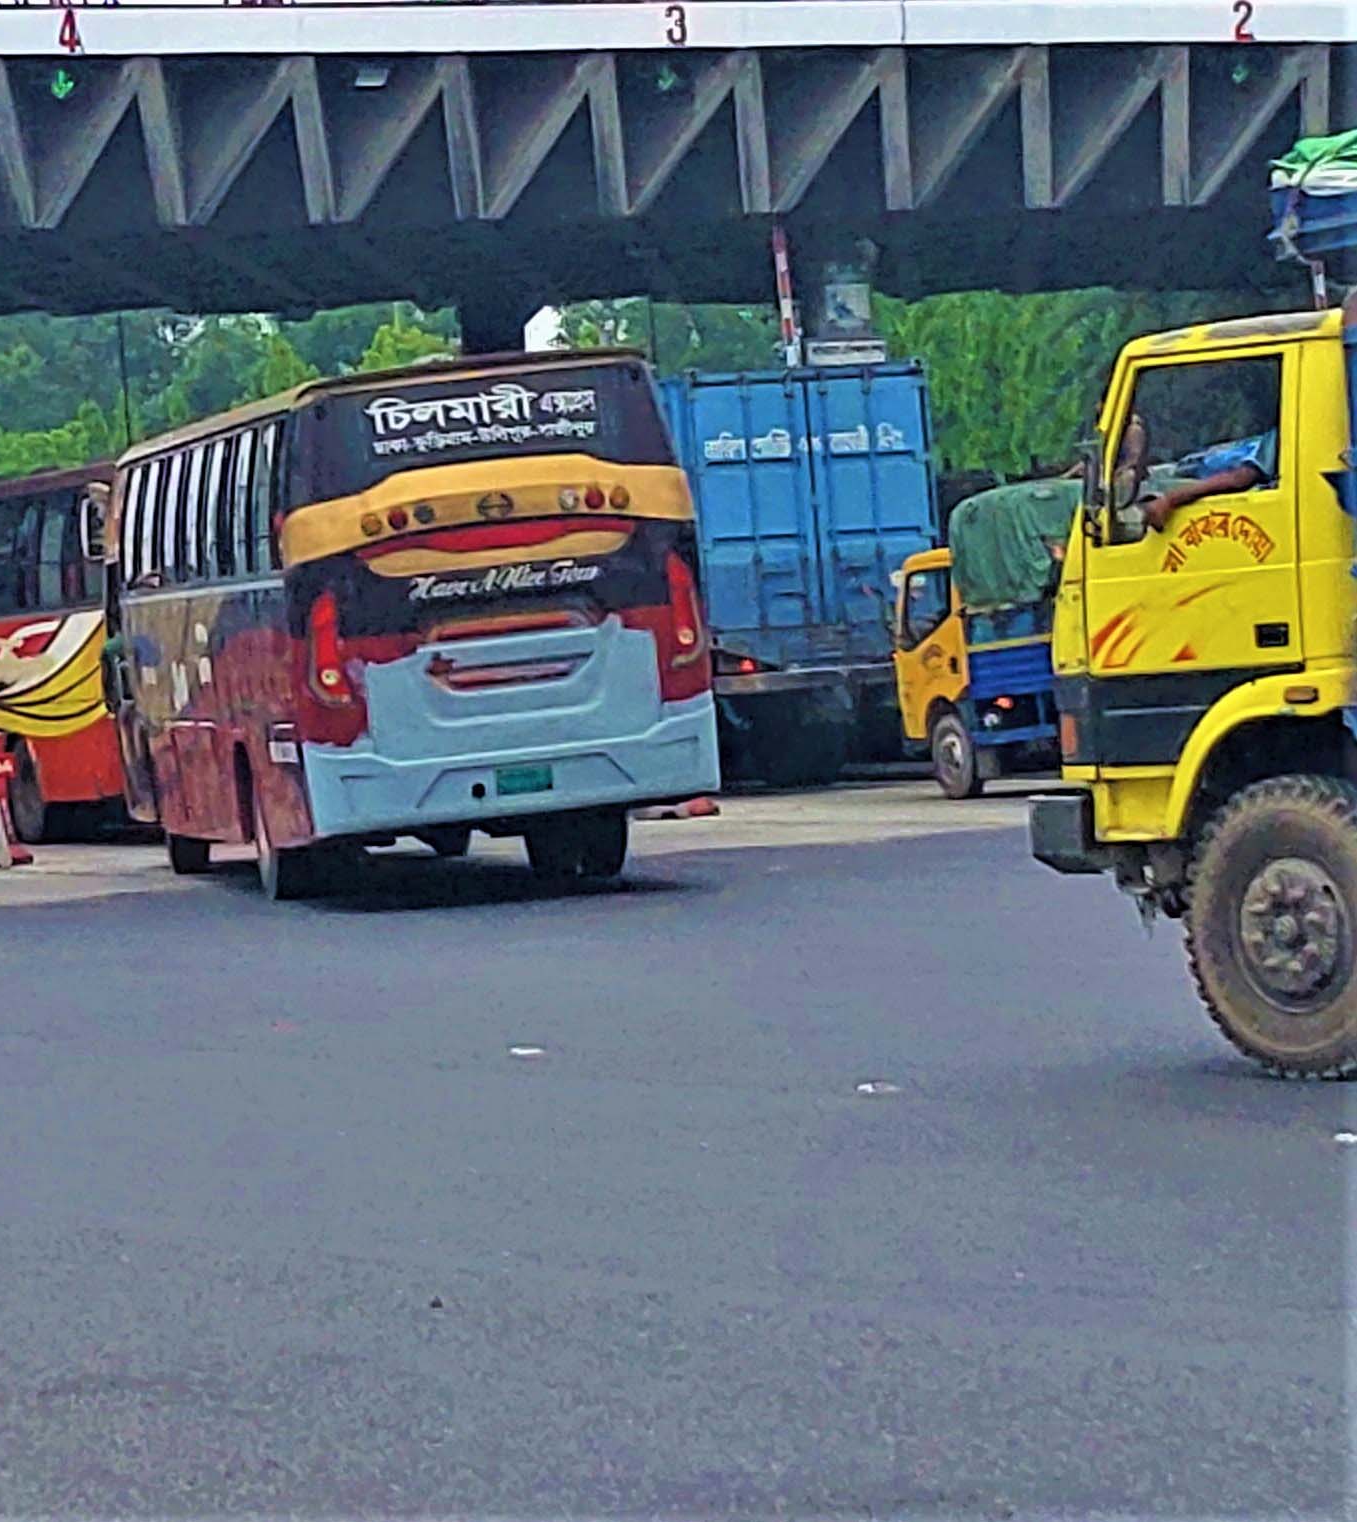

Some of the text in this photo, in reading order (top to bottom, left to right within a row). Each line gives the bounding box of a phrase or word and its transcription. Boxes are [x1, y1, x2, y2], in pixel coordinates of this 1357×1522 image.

[59, 9, 82, 53] 4
[665, 5, 687, 45] 3
[1233, 0, 1256, 42] 2
[364, 383, 537, 435] চিলমারী
